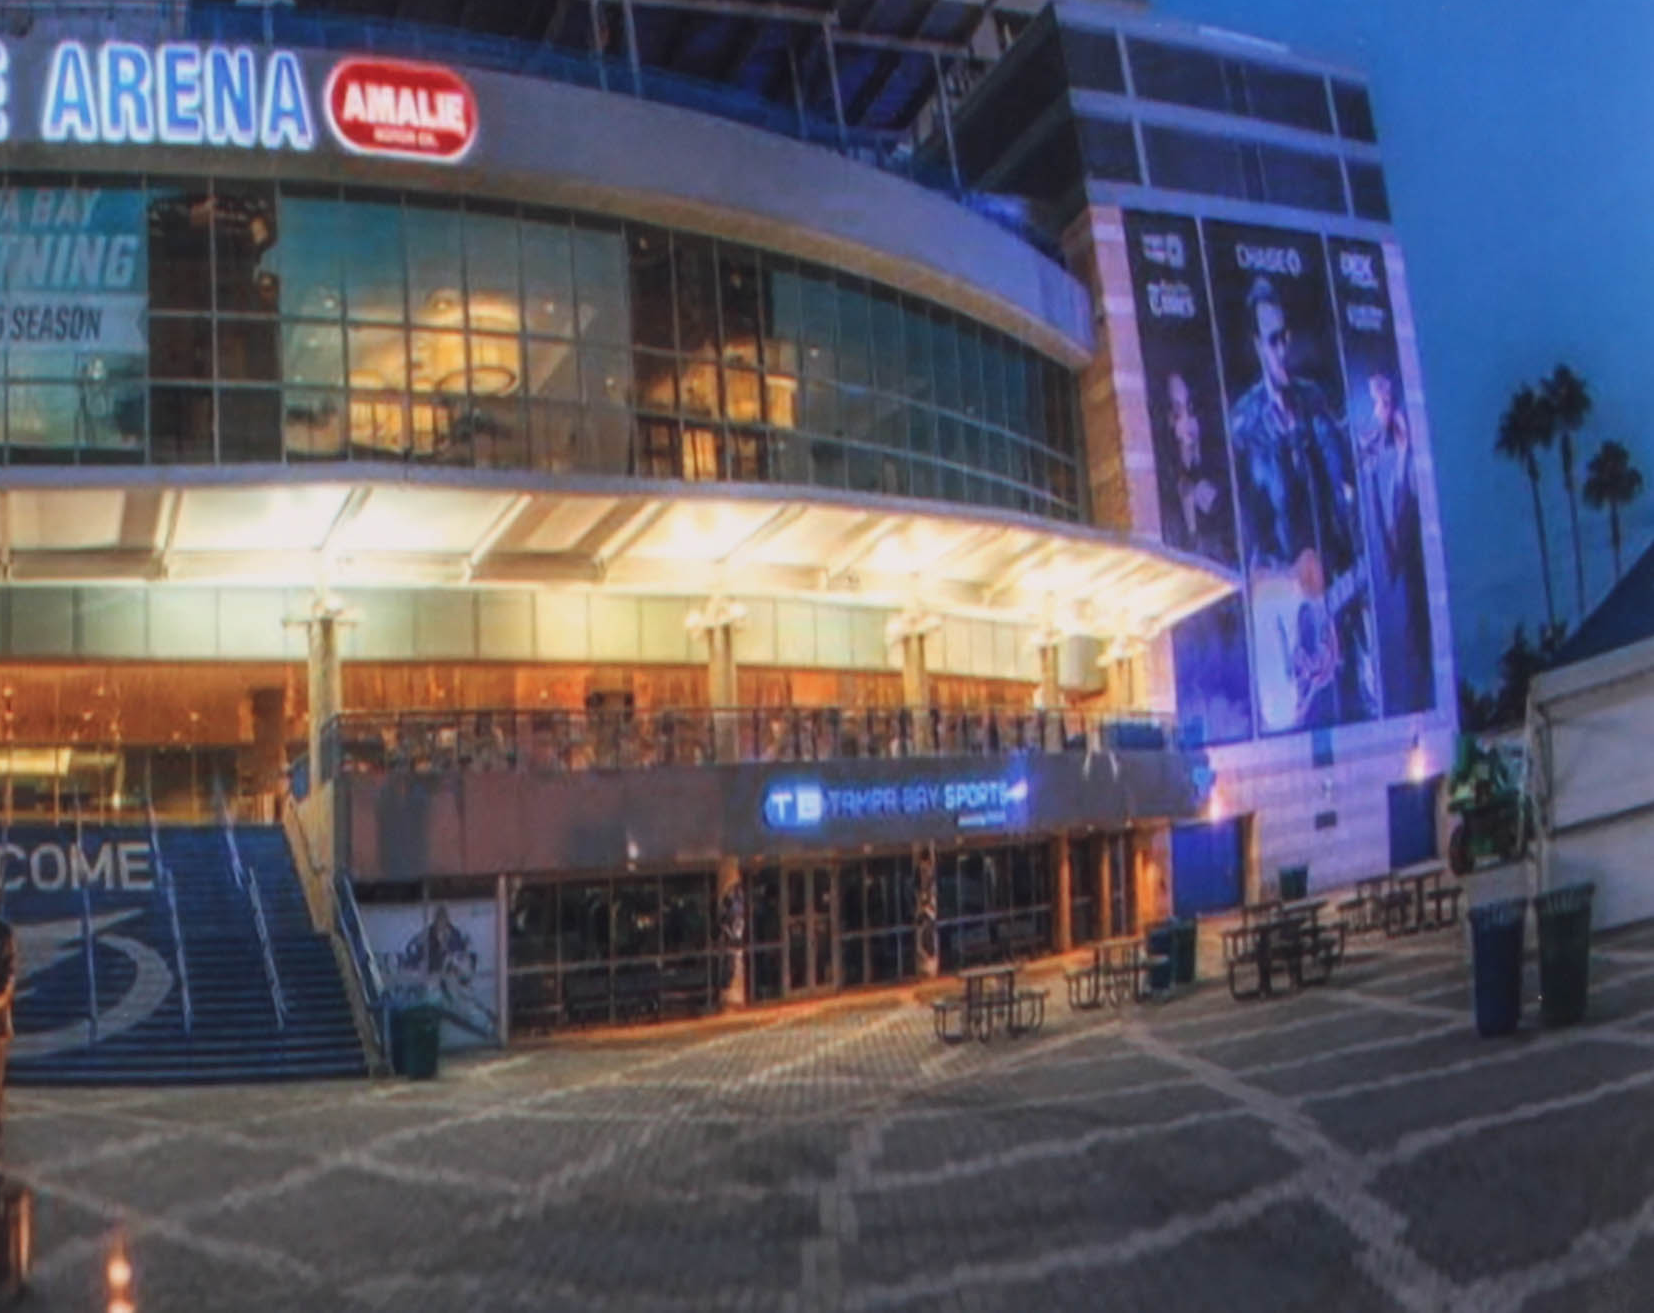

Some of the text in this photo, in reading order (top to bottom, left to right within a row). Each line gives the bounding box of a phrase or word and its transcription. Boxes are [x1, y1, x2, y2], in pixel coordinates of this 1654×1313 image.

[42, 40, 314, 150] ARENA
[342, 82, 467, 136] AMALIE
[29, 189, 102, 231] BAY
[9, 303, 103, 343] SEASON
[826, 789, 896, 818] TAMPA
[899, 785, 941, 814] BAY
